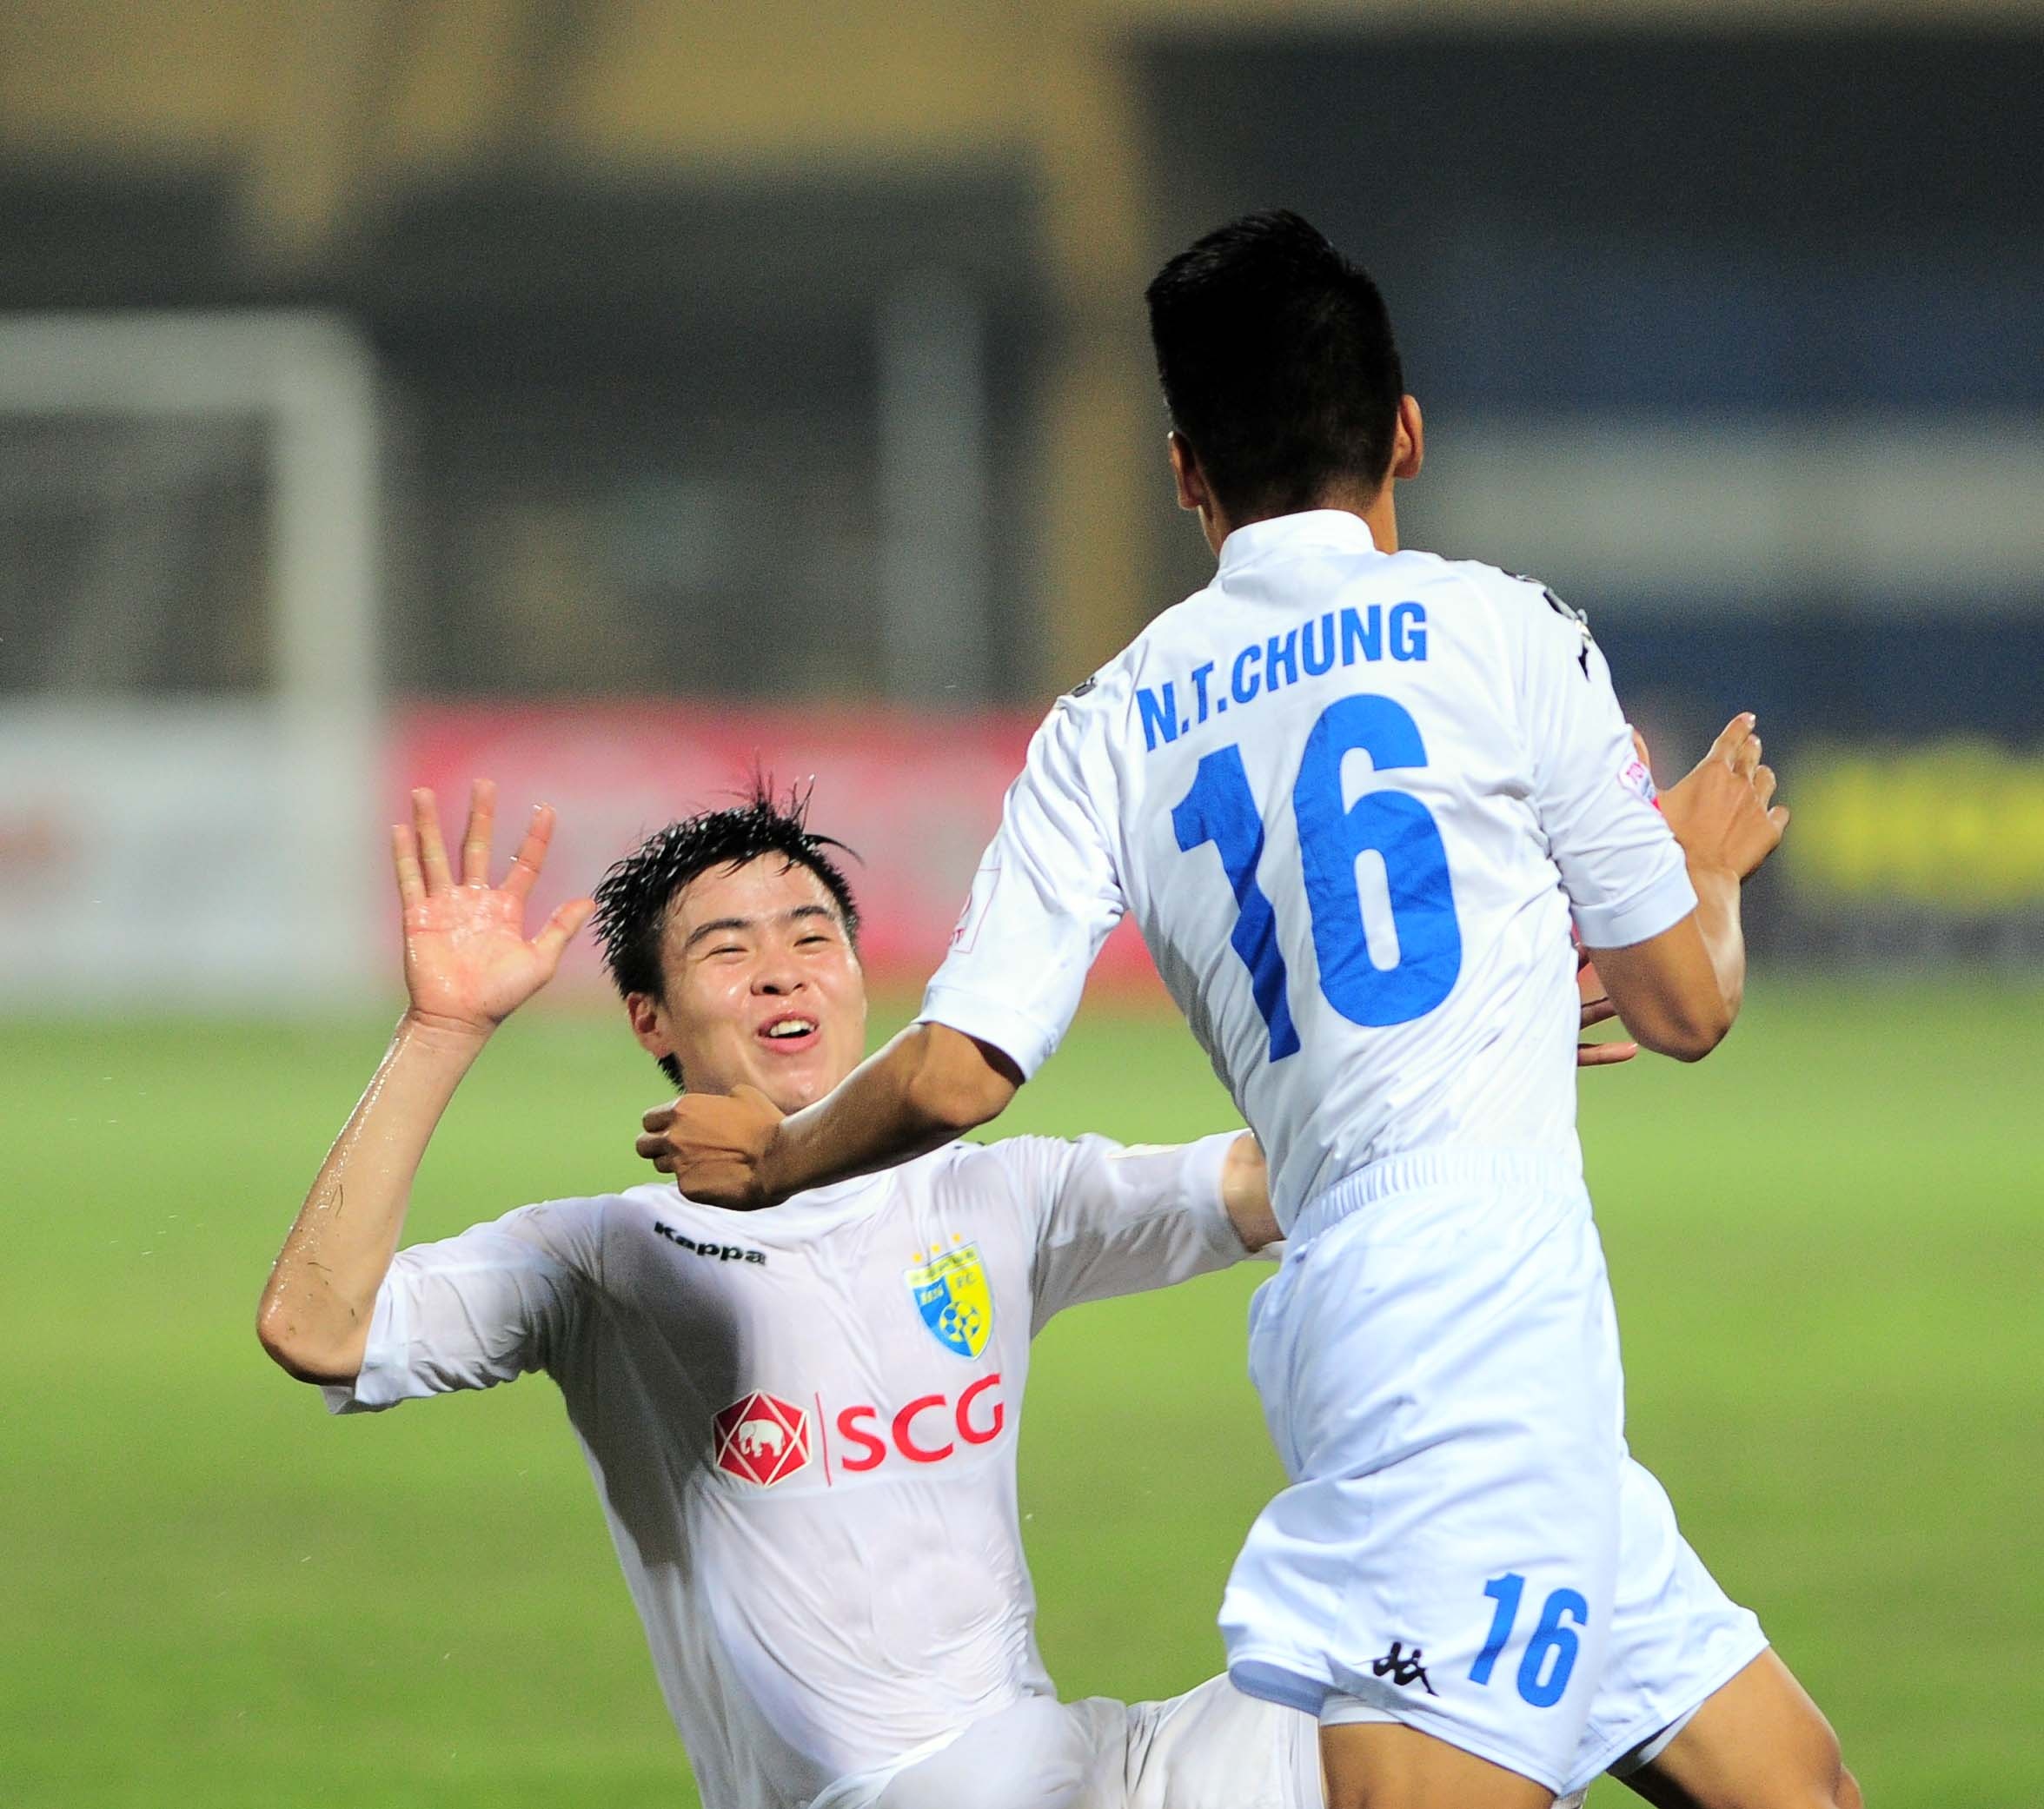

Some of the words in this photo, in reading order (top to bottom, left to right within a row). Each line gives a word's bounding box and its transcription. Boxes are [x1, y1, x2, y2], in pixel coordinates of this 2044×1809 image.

[1135, 601, 1427, 752] N.T.CHUNG
[1171, 693, 1463, 1064] 16
[654, 1221, 766, 1265] Kappa
[836, 1372, 1005, 1472] SCG
[1467, 1572, 1589, 1708] 16
